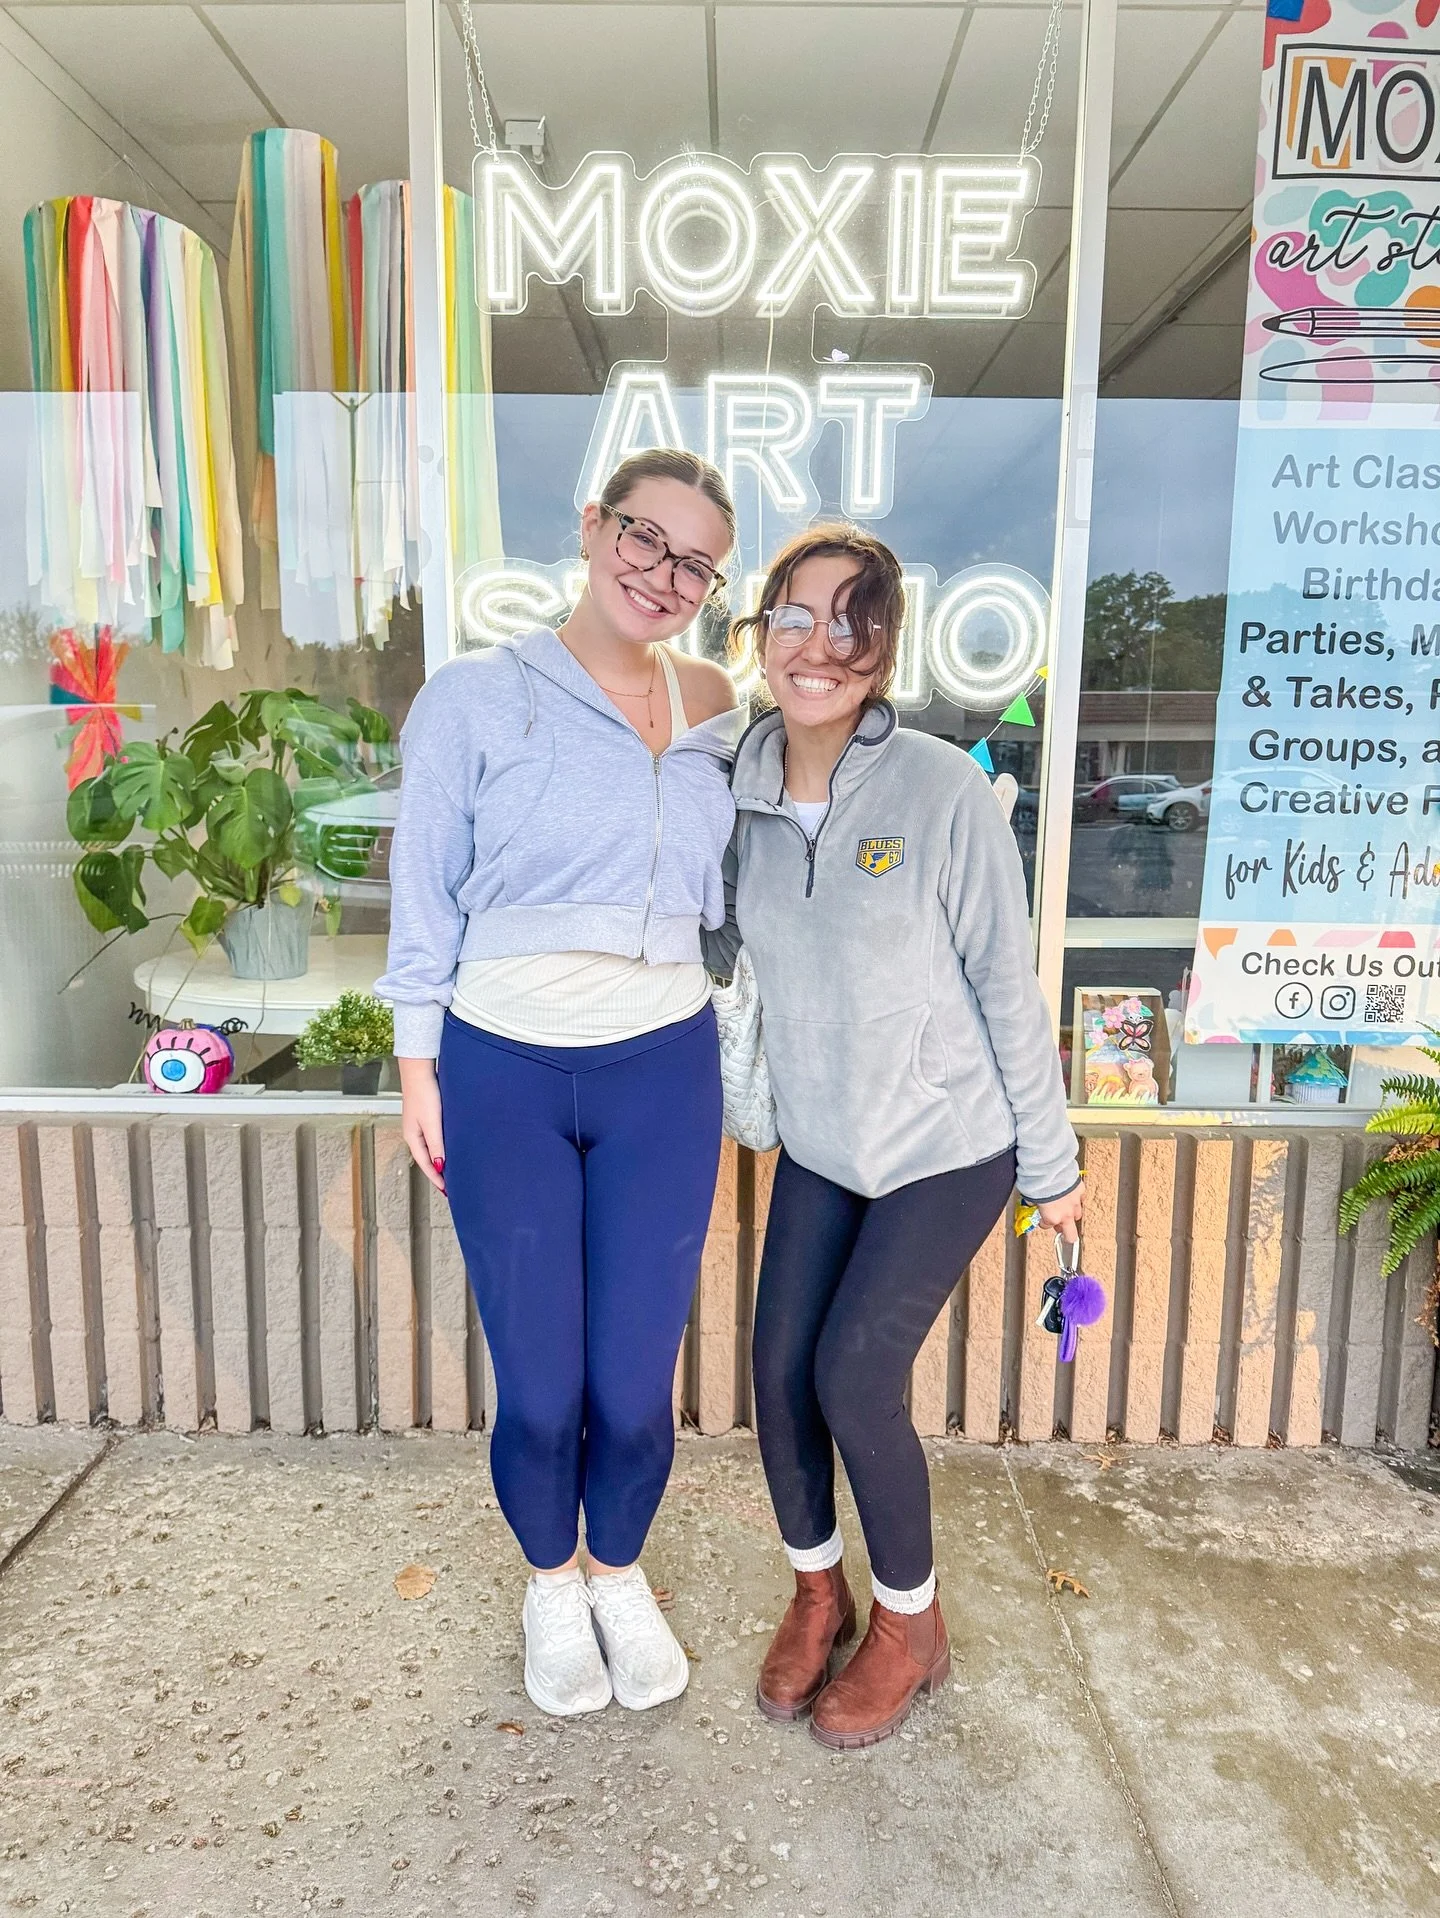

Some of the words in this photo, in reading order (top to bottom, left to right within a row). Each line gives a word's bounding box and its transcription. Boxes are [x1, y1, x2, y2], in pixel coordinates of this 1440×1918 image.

[1296, 66, 1440, 164] MO
[484, 164, 1030, 303] MOXIE
[1268, 203, 1395, 272] art
[1377, 205, 1440, 272] st
[588, 372, 921, 505] ART
[1271, 454, 1340, 489] Art
[1239, 621, 1395, 662] Parties,
[1241, 675, 1272, 708] &
[1286, 676, 1414, 716] Takes,
[1249, 728, 1407, 771] Groups,
[1240, 781, 1409, 816] Creative
[860, 839, 902, 851] BLUES
[888, 851, 900, 864] 67
[1225, 853, 1273, 900] for
[1282, 838, 1345, 898] Kids
[1356, 841, 1376, 892] &
[1241, 952, 1336, 977] Check
[1345, 953, 1383, 978] Us
